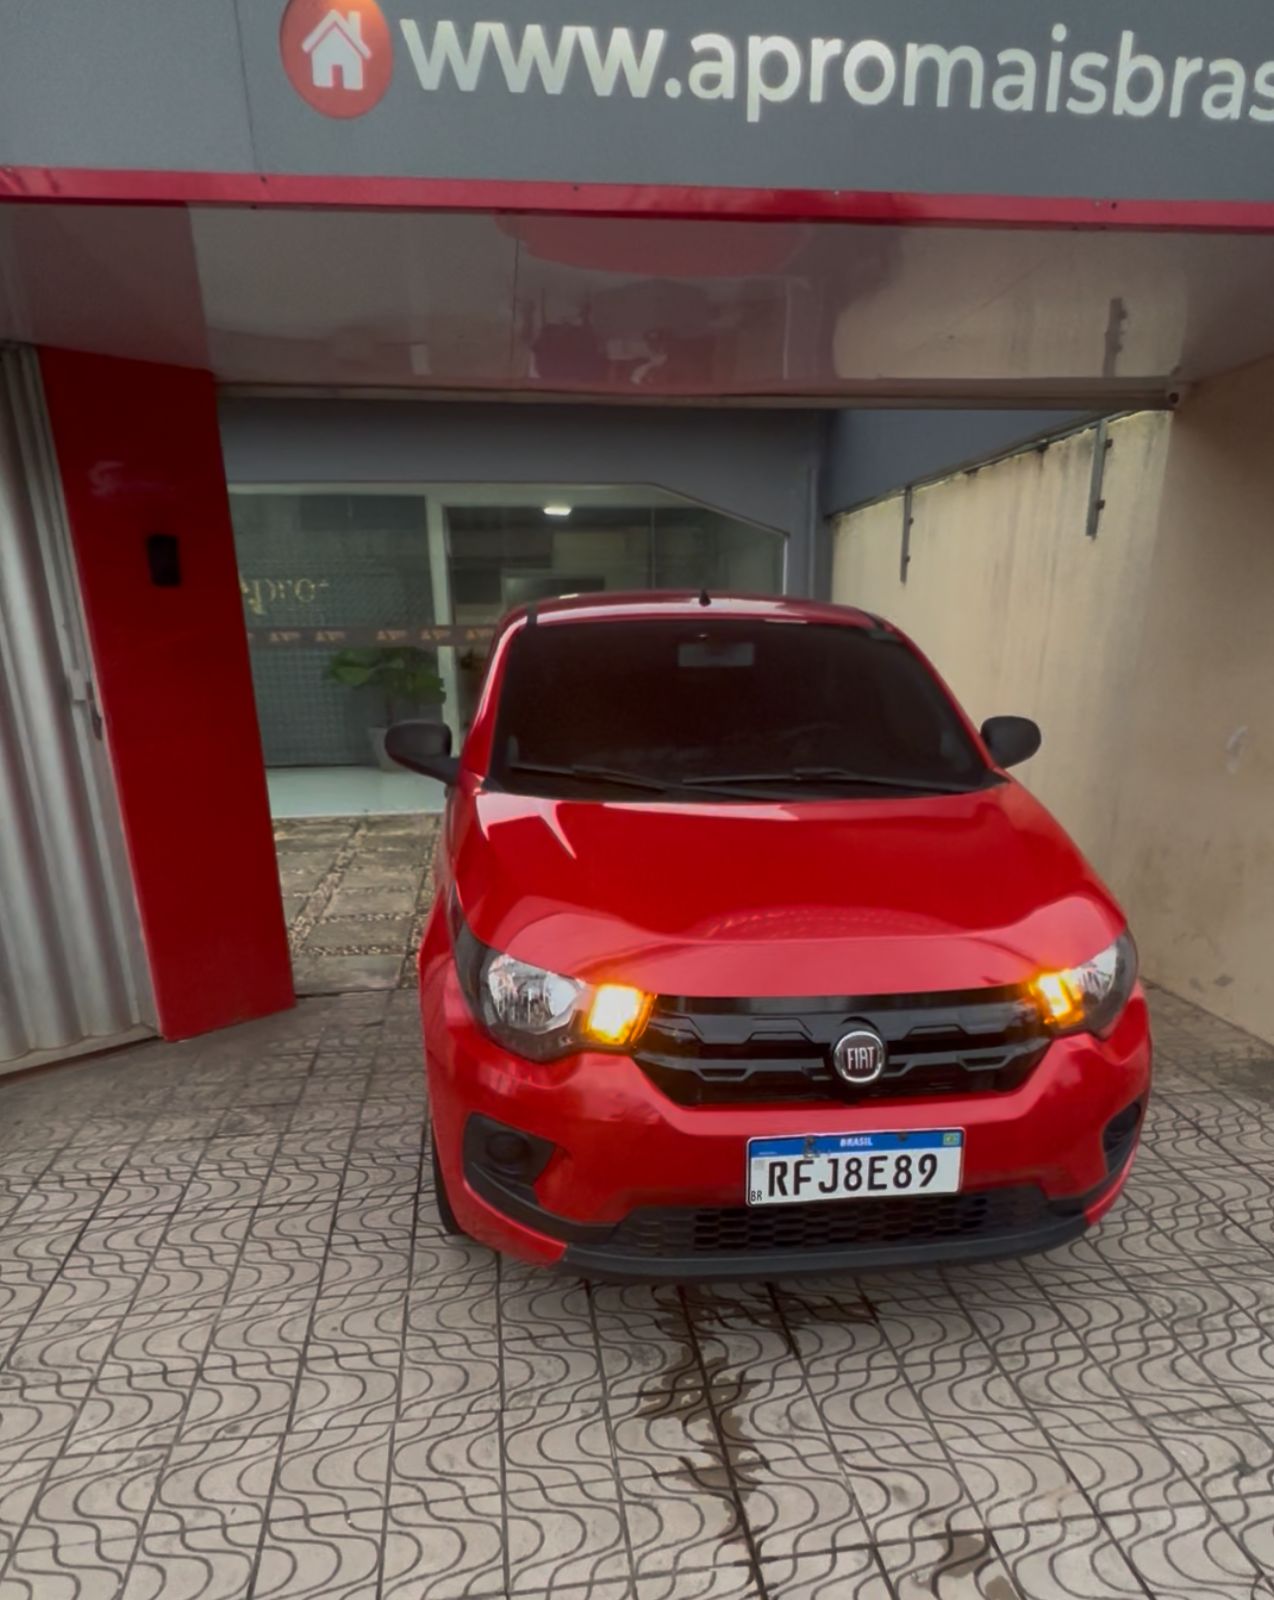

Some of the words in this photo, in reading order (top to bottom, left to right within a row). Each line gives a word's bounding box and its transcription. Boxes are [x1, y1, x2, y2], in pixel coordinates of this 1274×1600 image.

[399, 18, 1274, 123] www.apromaisbras
[847, 1046, 875, 1070] FIAT
[839, 1138, 873, 1148] BRASIL
[767, 1153, 938, 1197] RFJ8E89
[751, 1190, 763, 1201] BR
